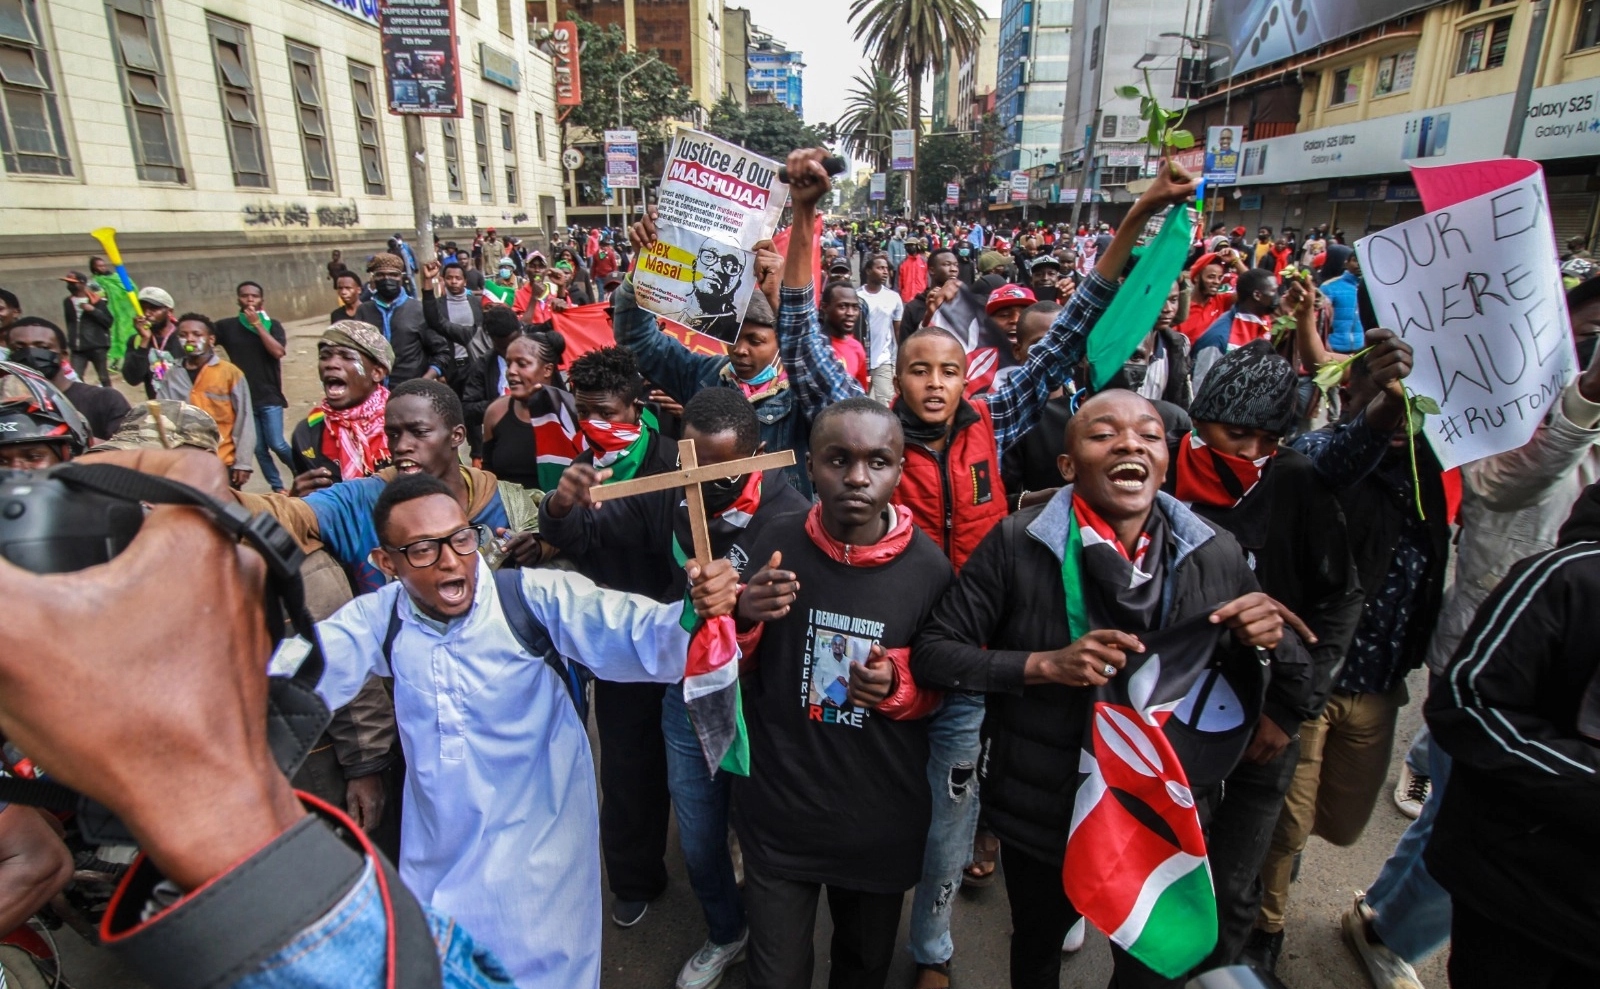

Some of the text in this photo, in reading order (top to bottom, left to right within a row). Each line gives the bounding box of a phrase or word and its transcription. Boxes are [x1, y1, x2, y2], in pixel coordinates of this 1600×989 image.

[382, 8, 419, 16] SUPERIOR
[390, 18, 442, 26] OPPOSITE NAIVAS
[383, 27, 450, 37] ALONG KENYATTA AVENUE
[1568, 95, 1593, 112] S25
[1535, 121, 1588, 138] Galaxy AI
[1303, 134, 1356, 151] Galaxy S25 Ultra
[676, 137, 776, 189] Justice 4 Our
[1311, 154, 1329, 164] Galaxy
[669, 161, 766, 211] MASHUJAA
[676, 192, 684, 200] and
[686, 196, 710, 208] prosecute
[718, 206, 744, 220] murderers!
[680, 204, 714, 218] compensation
[722, 216, 744, 226] victims!
[684, 218, 706, 230] shattered
[694, 214, 712, 226] Dreams
[720, 222, 738, 234] several
[651, 239, 670, 259] Rex
[1368, 212, 1472, 285] OUR
[645, 254, 682, 280] Masai
[1392, 263, 1538, 338] WERE
[808, 608, 885, 639] I DEMAND JUSTICE
[800, 625, 814, 708] ALBERT
[808, 705, 863, 729] REKE
